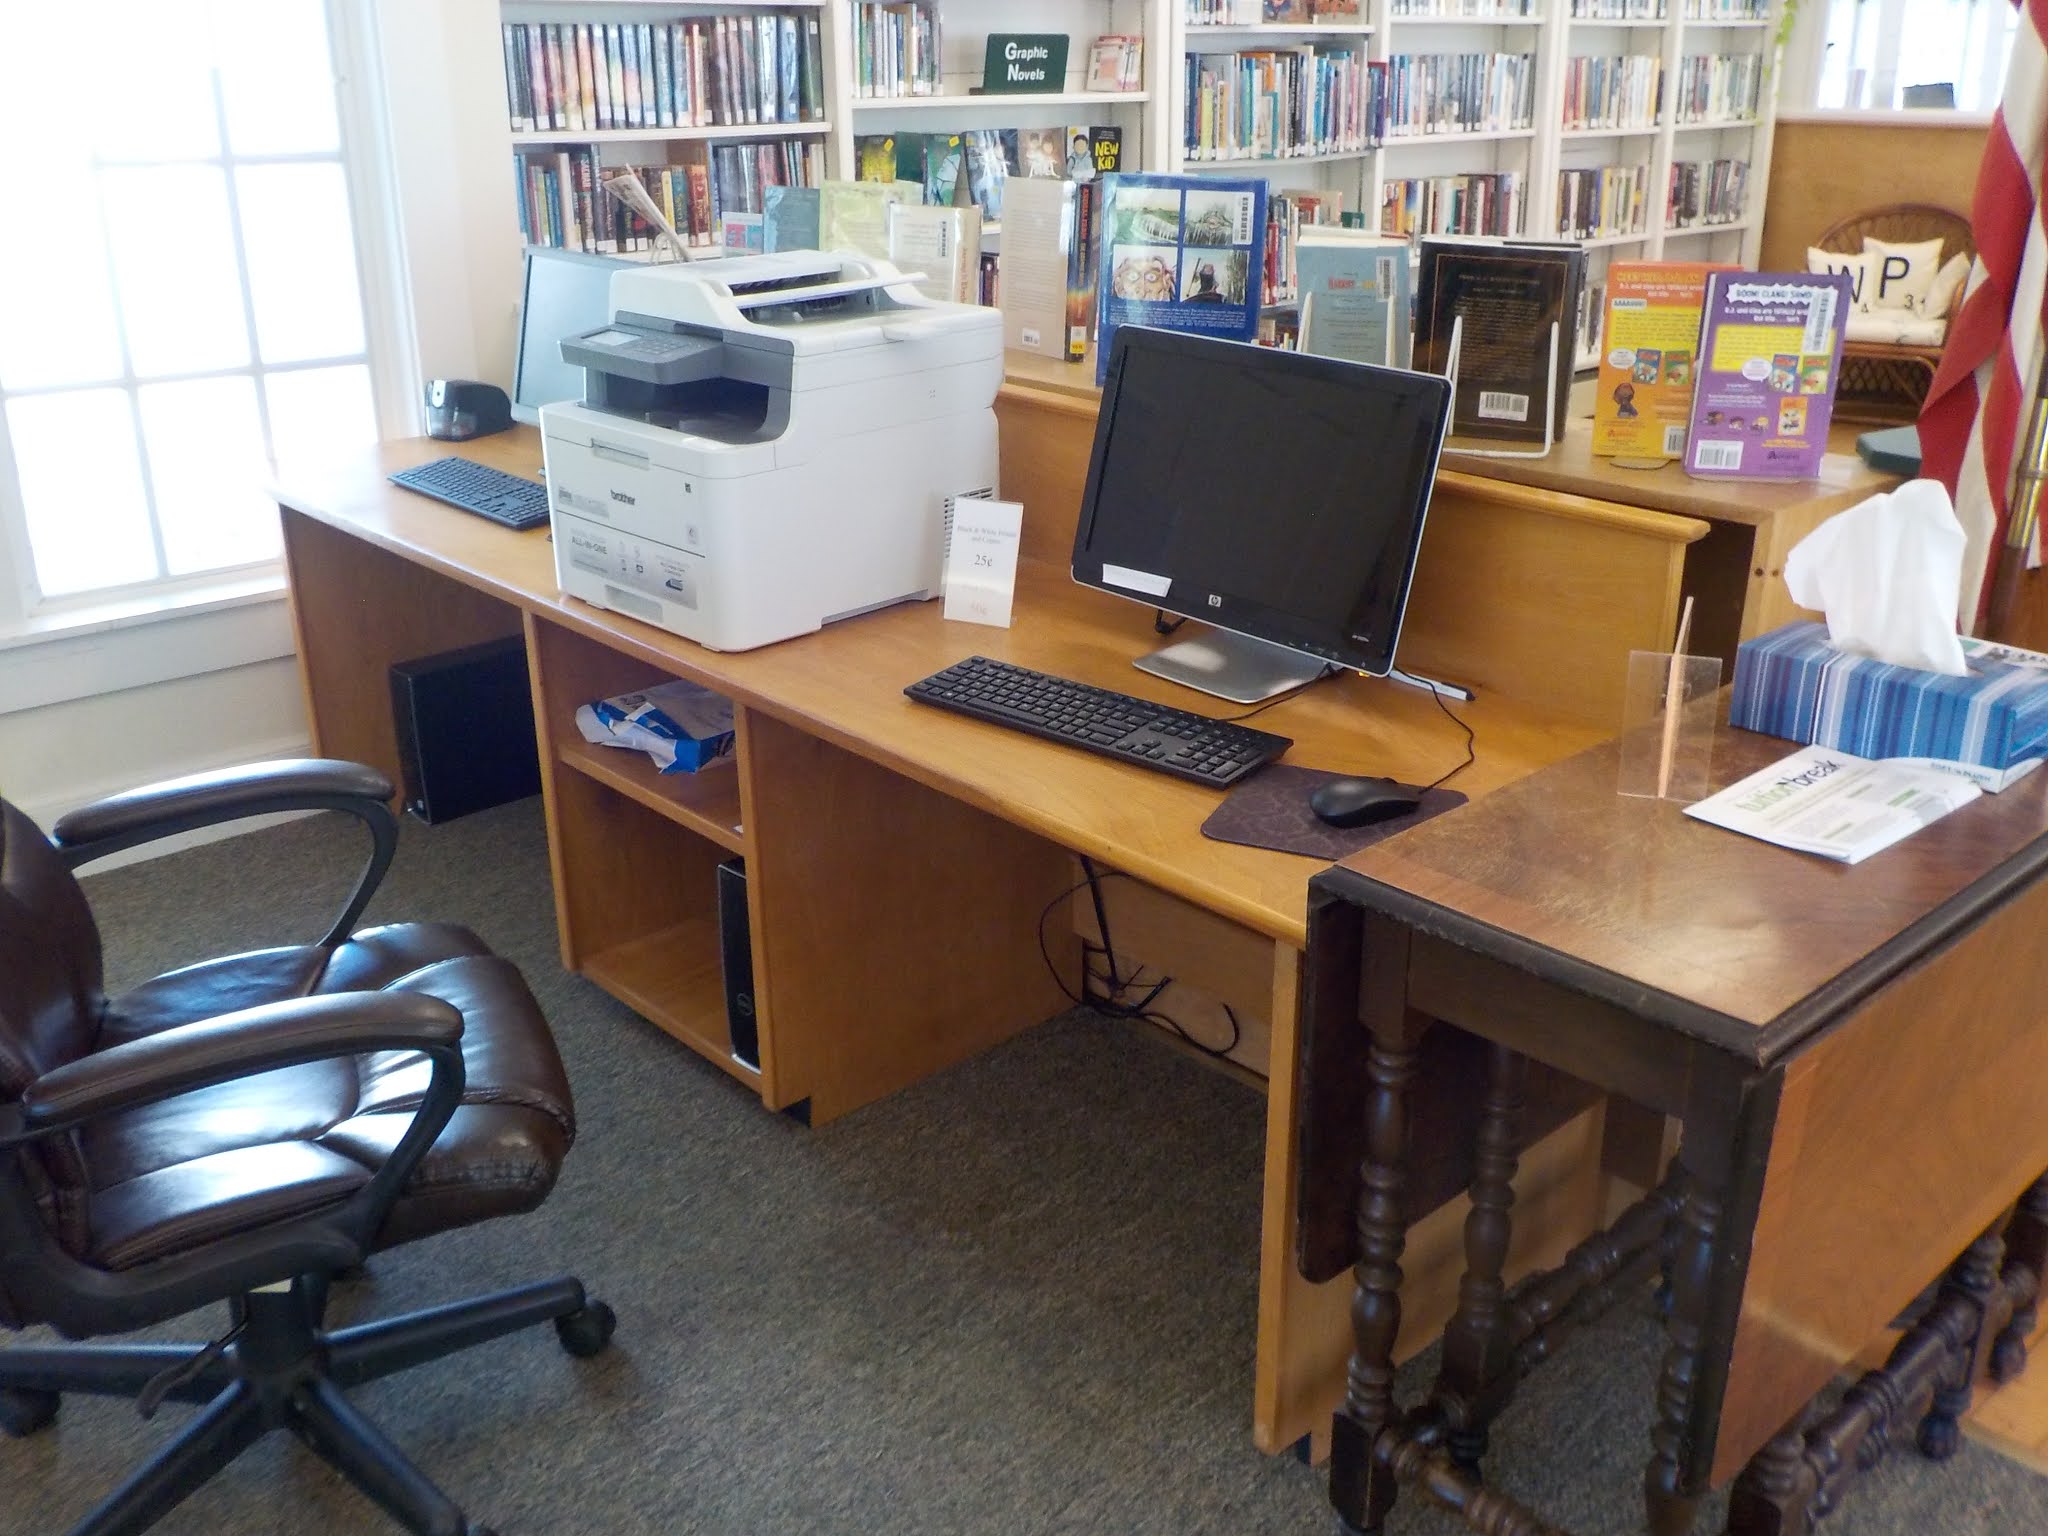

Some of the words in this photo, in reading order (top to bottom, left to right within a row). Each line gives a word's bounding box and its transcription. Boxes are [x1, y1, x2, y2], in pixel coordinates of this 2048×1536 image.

[1005, 42, 1048, 61] Graphic
[1007, 63, 1046, 81] Novels
[1095, 141, 1119, 156] NEW
[1879, 257, 1910, 299] P
[1904, 294, 1914, 310] 3
[974, 554, 993, 567] 25¢
